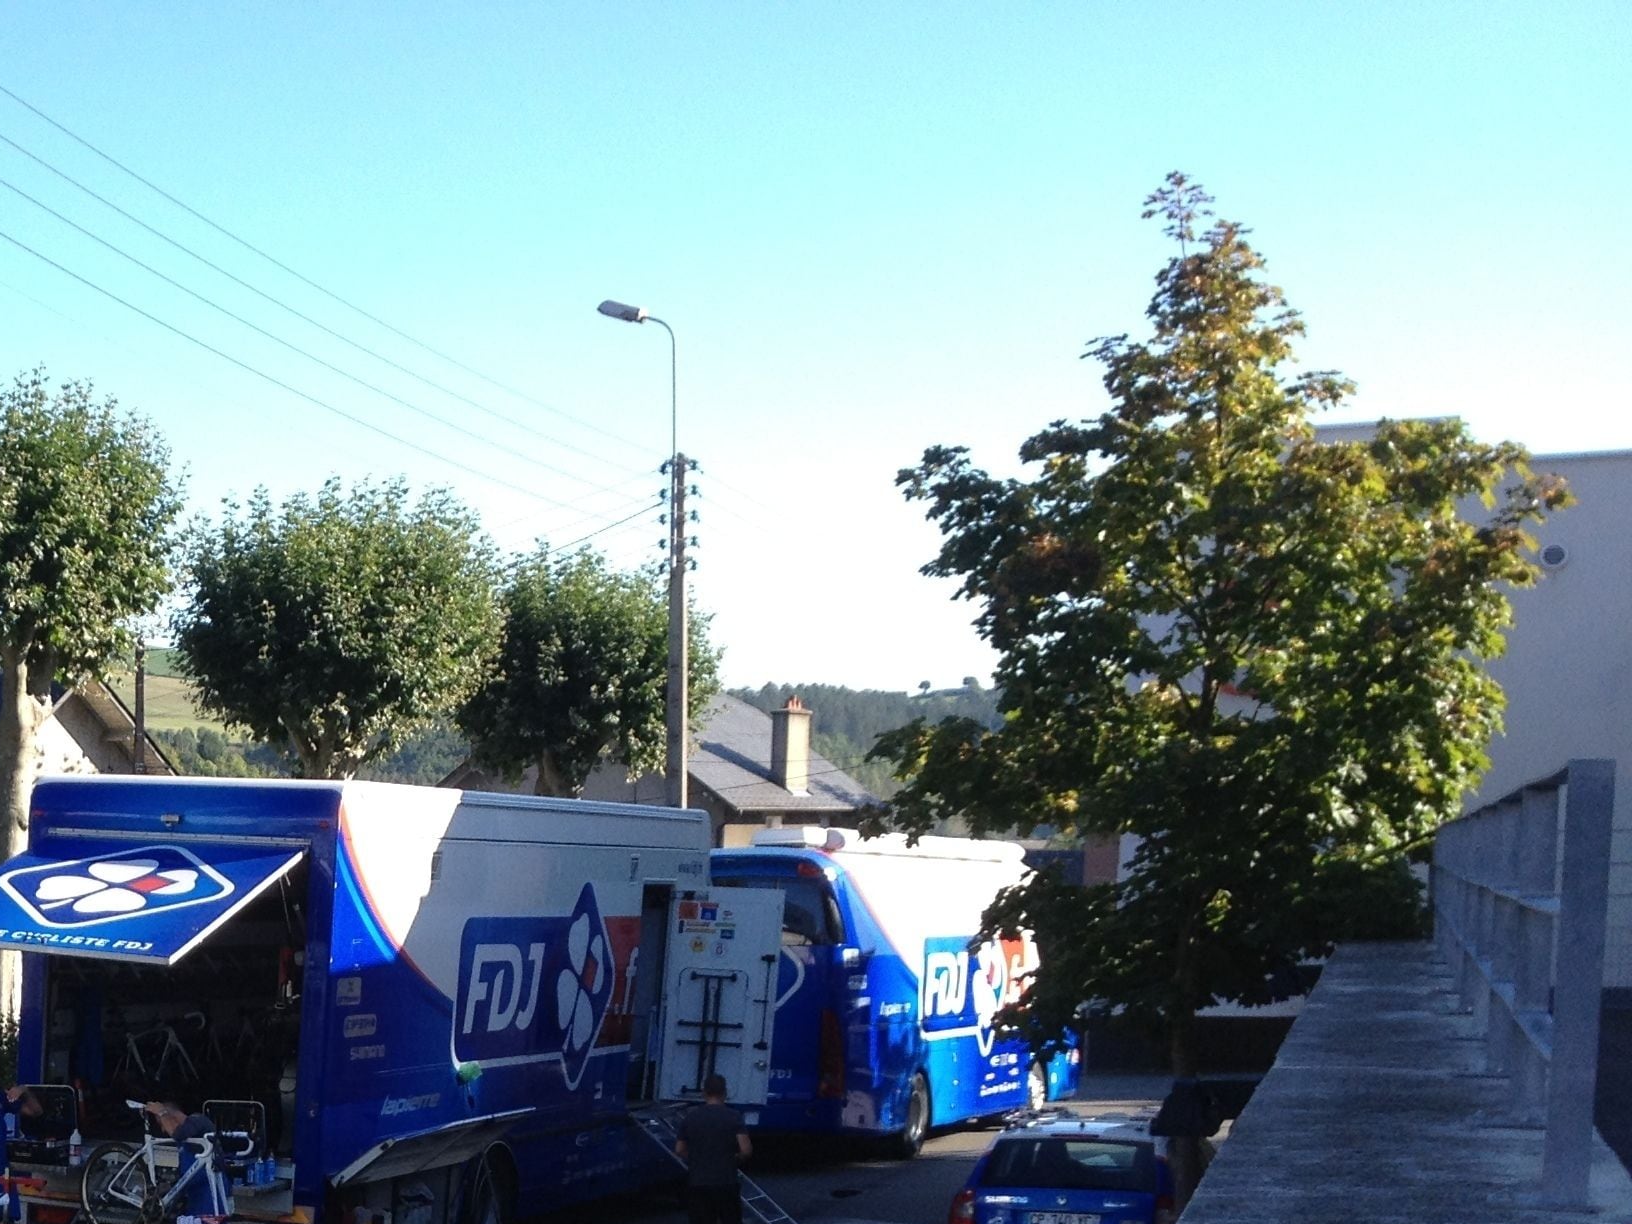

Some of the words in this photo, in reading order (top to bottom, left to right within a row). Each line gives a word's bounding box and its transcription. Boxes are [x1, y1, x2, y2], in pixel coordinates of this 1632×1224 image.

[112, 940, 154, 951] FDJ
[462, 942, 546, 1036] FDJ
[924, 951, 968, 1017] FDJ
